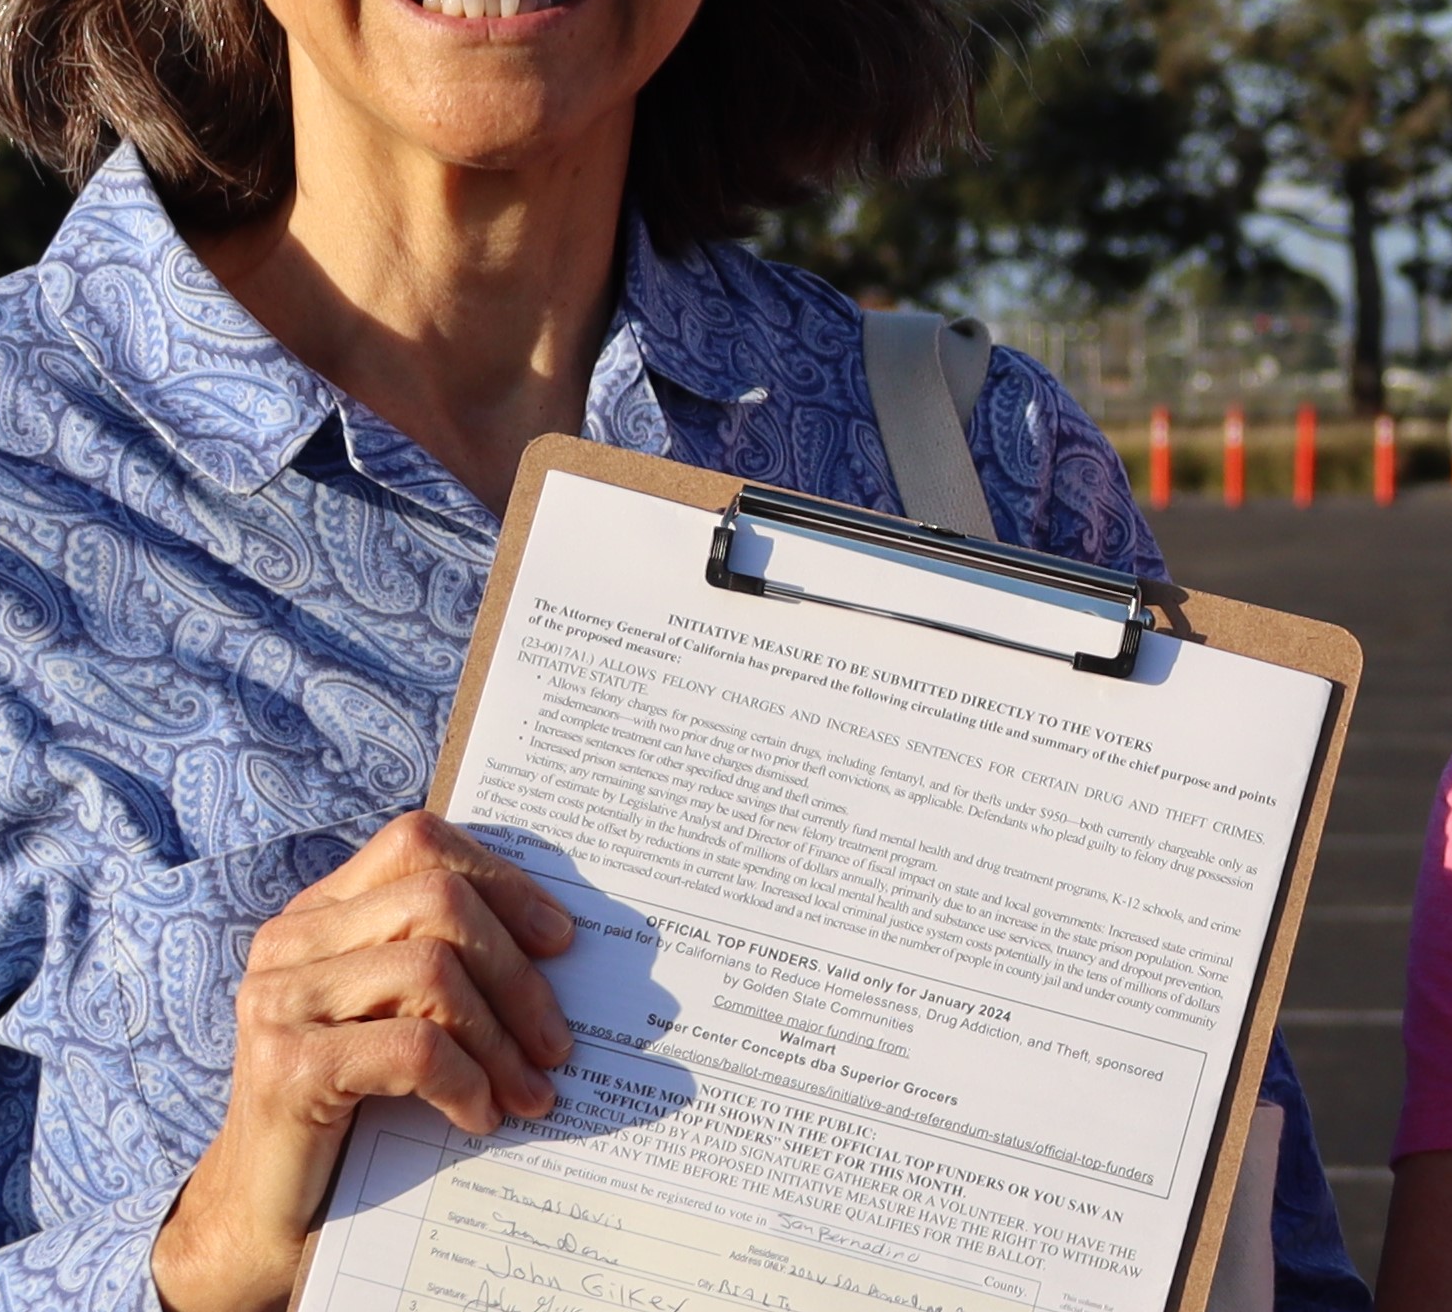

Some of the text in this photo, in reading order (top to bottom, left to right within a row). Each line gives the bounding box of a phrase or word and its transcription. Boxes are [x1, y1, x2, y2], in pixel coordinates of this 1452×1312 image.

[528, 614, 543, 625] of
[543, 617, 564, 632] the
[564, 625, 623, 648] proposed
[534, 597, 1276, 806] The Attorney General of California has prepared the following circulating title and summary of the chief purpose and points
[667, 613, 1152, 753] INITIATIVE MEASURE TO BE SUBMITTED DIRECTLY TO THE VOTERS
[602, 924, 633, 940] paid
[634, 929, 653, 945] for
[655, 936, 673, 952] by
[675, 941, 751, 972] Californians
[754, 962, 768, 976] to
[769, 966, 821, 990] Reduce
[925, 1007, 958, 1029] Drug
[1026, 1037, 1053, 1052] and
[1094, 1055, 1164, 1082] sponsored
[645, 915, 1011, 1022] OFFICIAL TOP FUNDERS. Valid only for January 2024
[646, 1013, 958, 1106] Super Center Concepts dba Superior Grocers
[711, 994, 783, 1025] Committee
[785, 1016, 824, 1035] major
[825, 1023, 875, 1049] funding
[779, 1029, 836, 1056] Walmart
[563, 1064, 1123, 1223] IS THE SAME MONTH SHOWN IN THE OFFICIAL TOP FUNDERS OR YOU SAW AN
[673, 1109, 703, 1126] TOP
[782, 1139, 833, 1161] SHEET
[834, 1152, 865, 1171] FOR
[869, 1161, 904, 1181] THIS
[698, 1083, 876, 1140] NOTICE TO THE PUBLIC:
